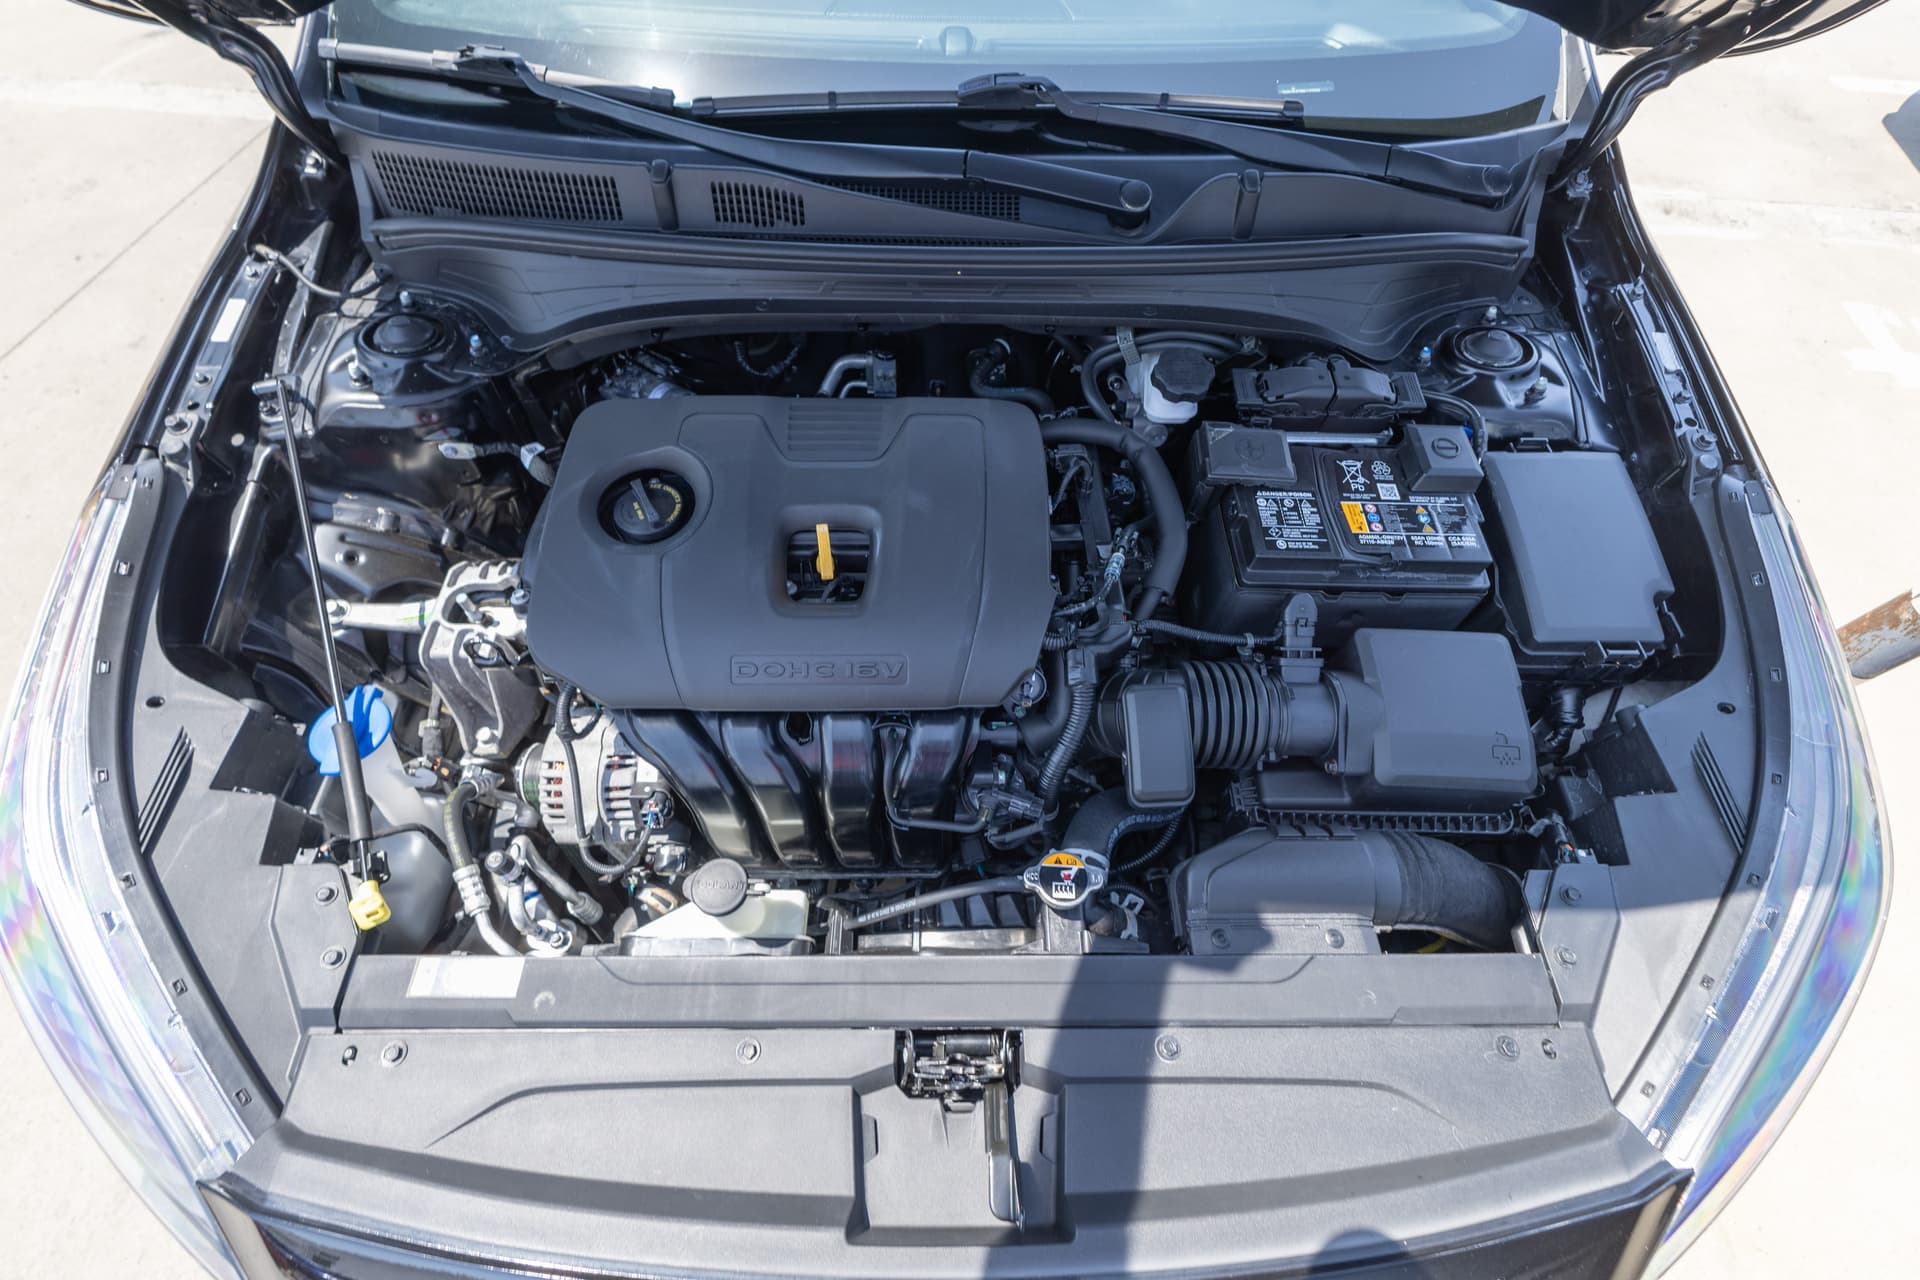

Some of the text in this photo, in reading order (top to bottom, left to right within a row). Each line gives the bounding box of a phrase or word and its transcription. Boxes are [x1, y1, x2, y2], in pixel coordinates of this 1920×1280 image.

[1351, 483, 1365, 492] Pb
[734, 661, 905, 680] DOHC 16V
[1026, 871, 1040, 881] HCC
